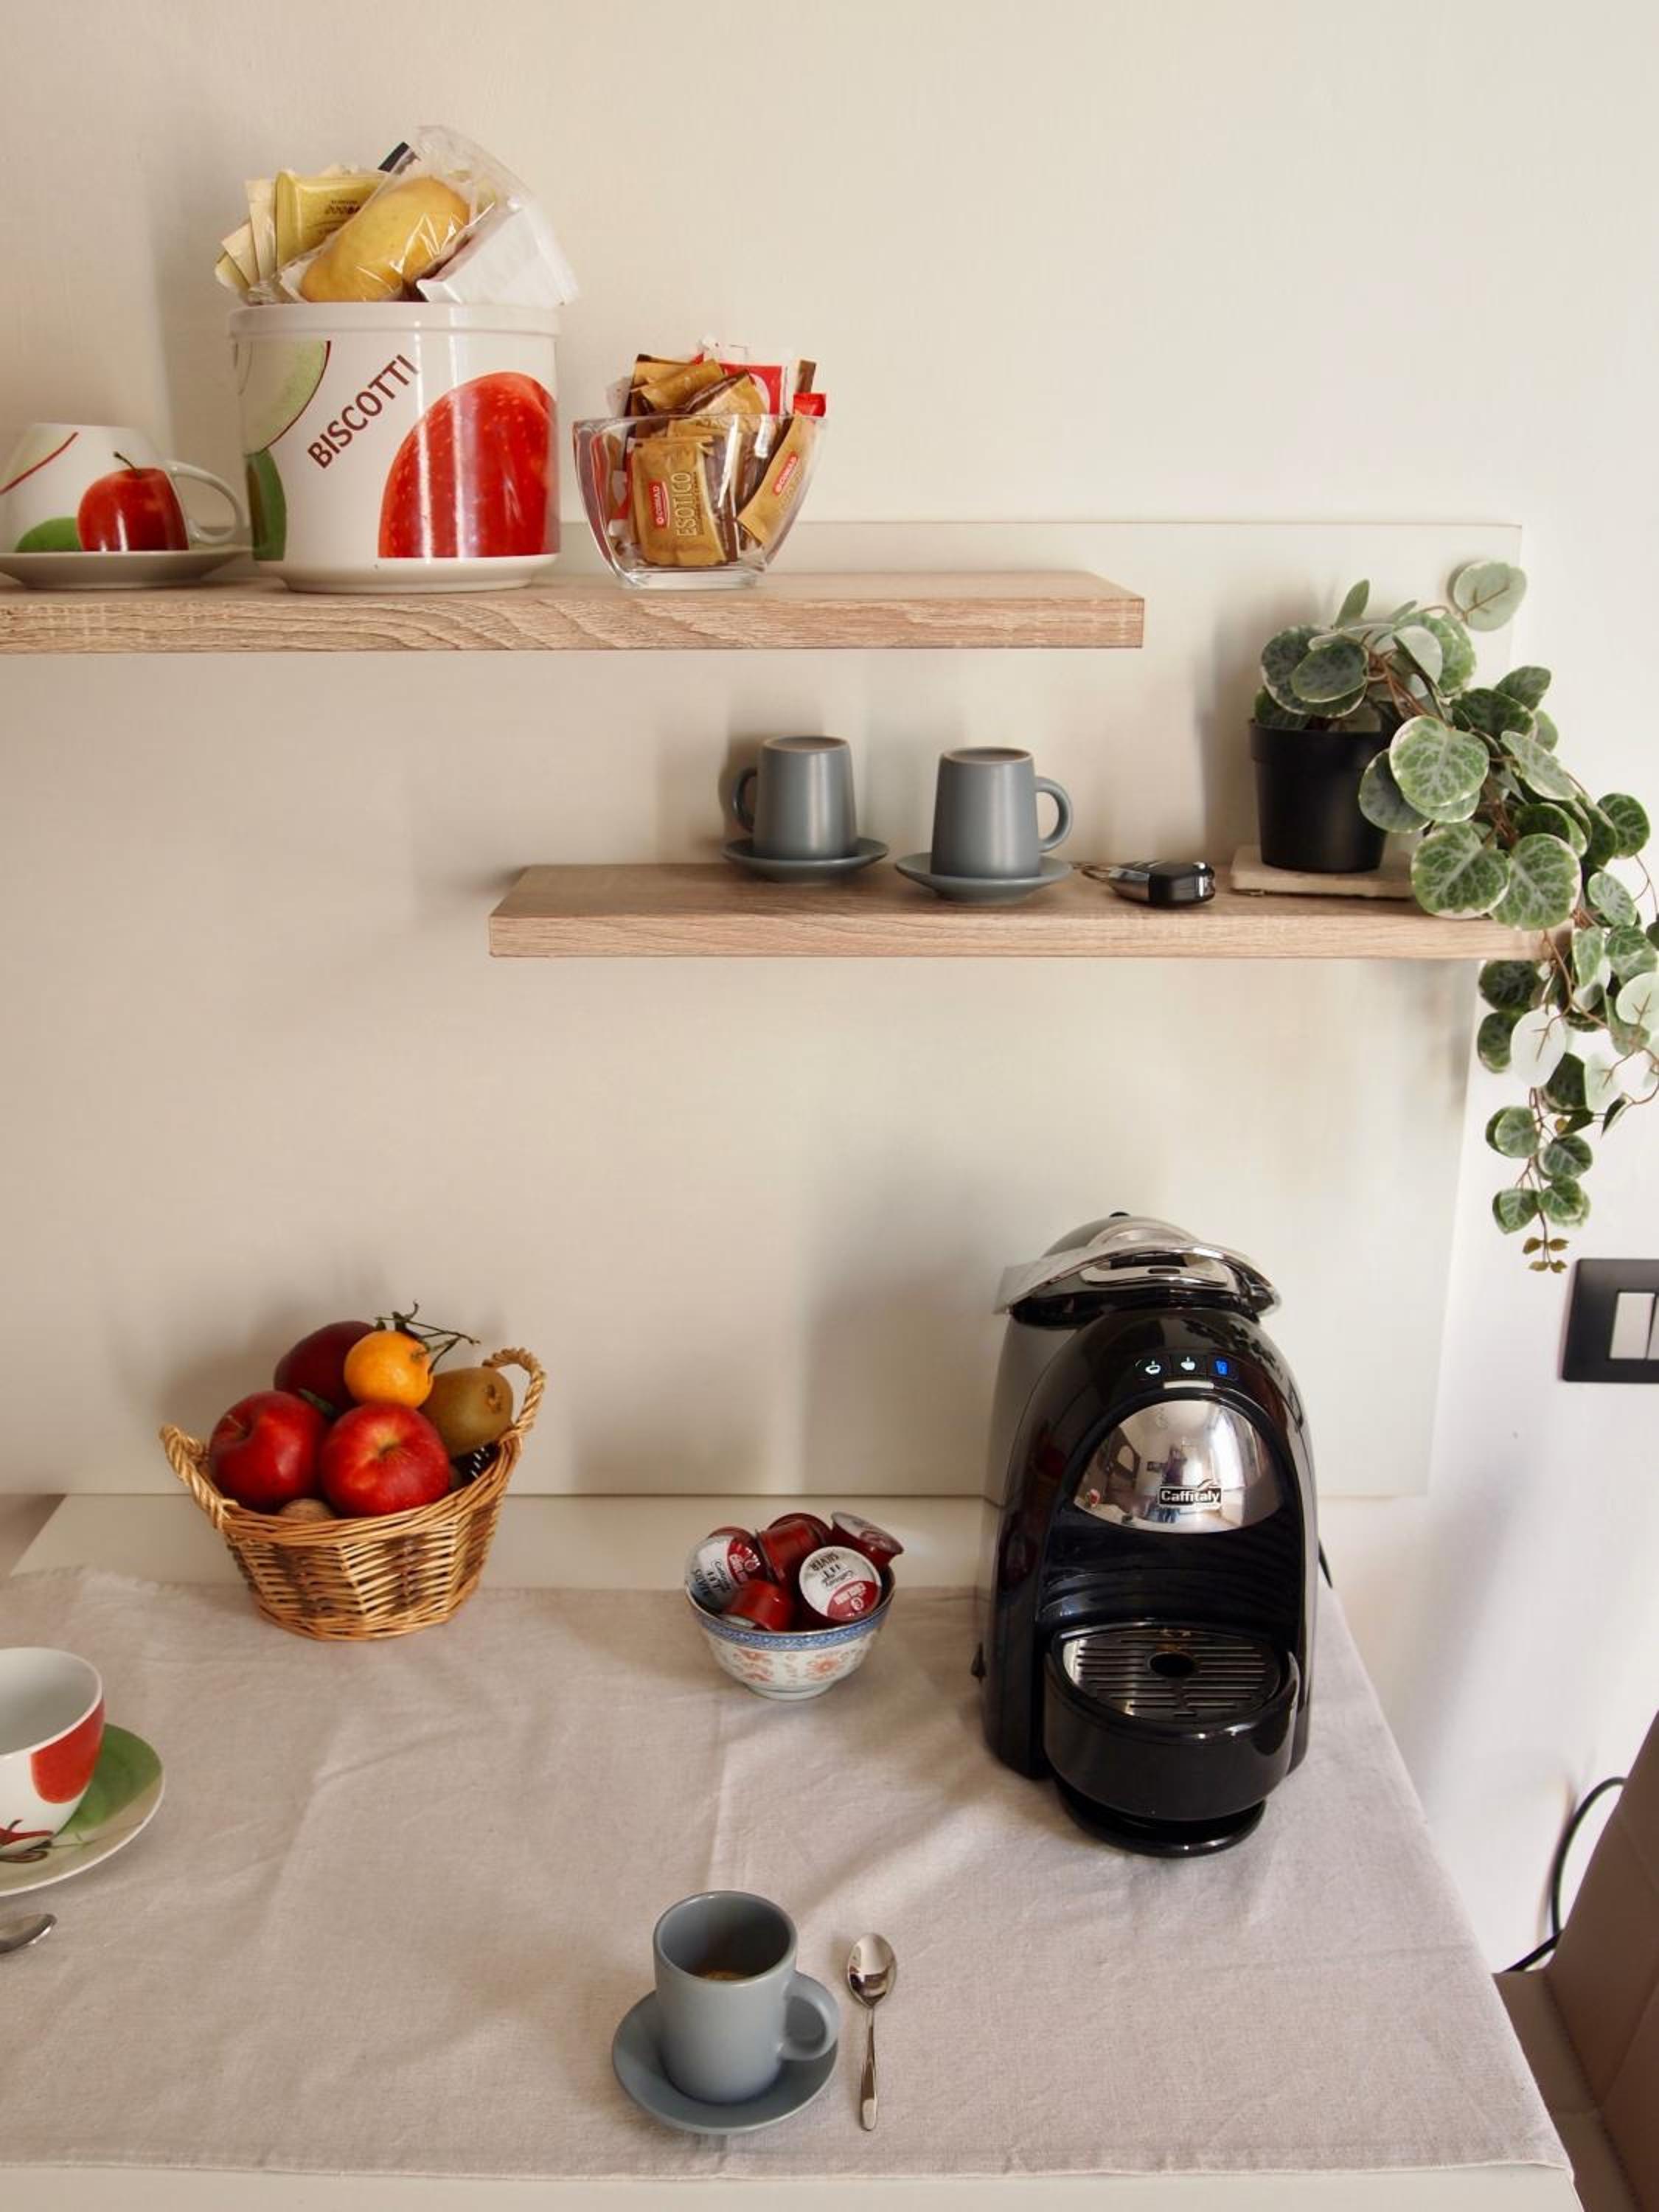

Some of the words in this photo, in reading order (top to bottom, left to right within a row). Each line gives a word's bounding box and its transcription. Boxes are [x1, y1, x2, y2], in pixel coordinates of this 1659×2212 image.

[307, 354, 419, 469] BISCOTTI
[670, 473, 697, 536] ESOTICO
[1161, 1490, 1220, 1505] Caffitaly
